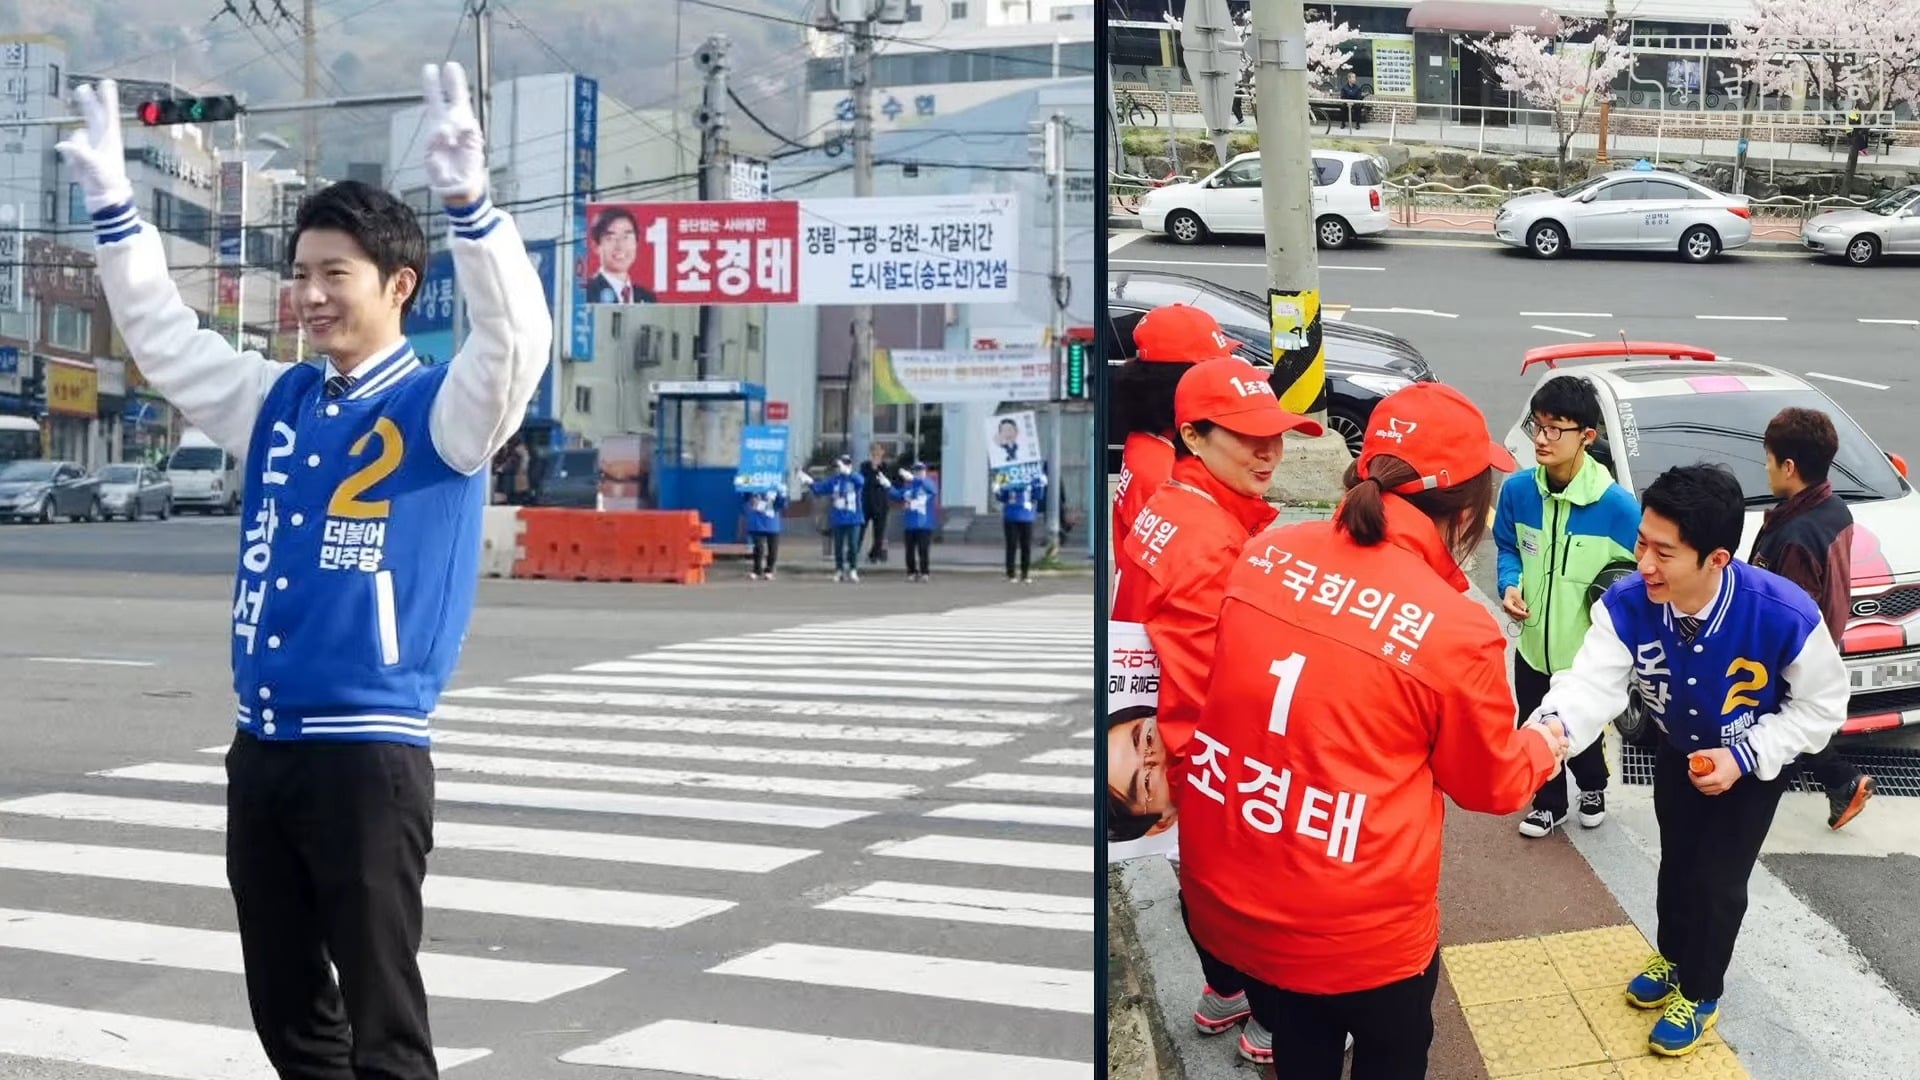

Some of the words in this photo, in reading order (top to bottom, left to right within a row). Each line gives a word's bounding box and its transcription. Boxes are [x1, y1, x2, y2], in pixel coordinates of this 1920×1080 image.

[645, 216, 668, 292] 1
[676, 238, 791, 296] 조경태
[805, 223, 993, 255] 장림-구평-감천-자갈치간
[849, 258, 1008, 290] 도시철도(송도선)건설
[326, 416, 404, 519] 2
[319, 545, 383, 573] 민주당
[322, 519, 386, 547] 더불어
[1281, 559, 1435, 650] 국회의원
[1268, 651, 1306, 737] 1
[1636, 639, 1673, 735] 오창
[1720, 656, 1769, 716] 2
[1186, 729, 1367, 864] 조경태
